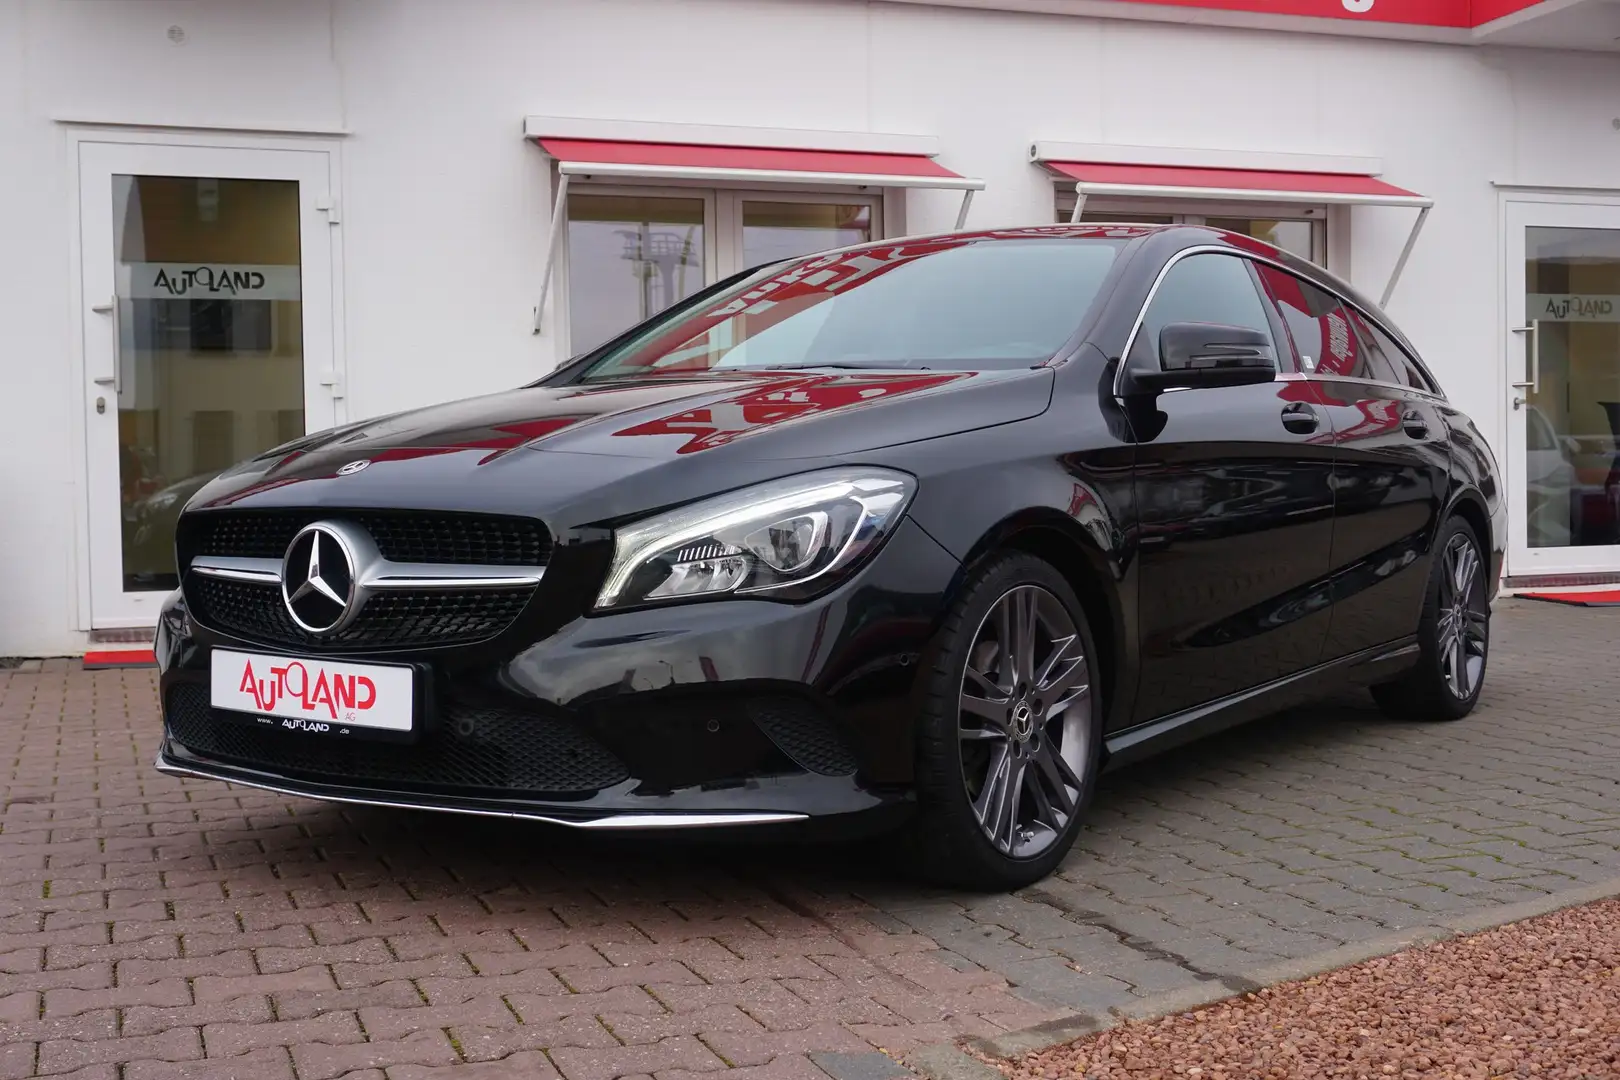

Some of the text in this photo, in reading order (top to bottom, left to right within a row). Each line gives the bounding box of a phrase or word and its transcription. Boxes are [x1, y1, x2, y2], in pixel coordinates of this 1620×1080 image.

[154, 267, 265, 295] AUTOLAND
[1545, 296, 1613, 319] AUTOLAND
[239, 658, 377, 720] AUTOLAND
[281, 719, 330, 733] AUTOLAND
[344, 712, 356, 722] AG
